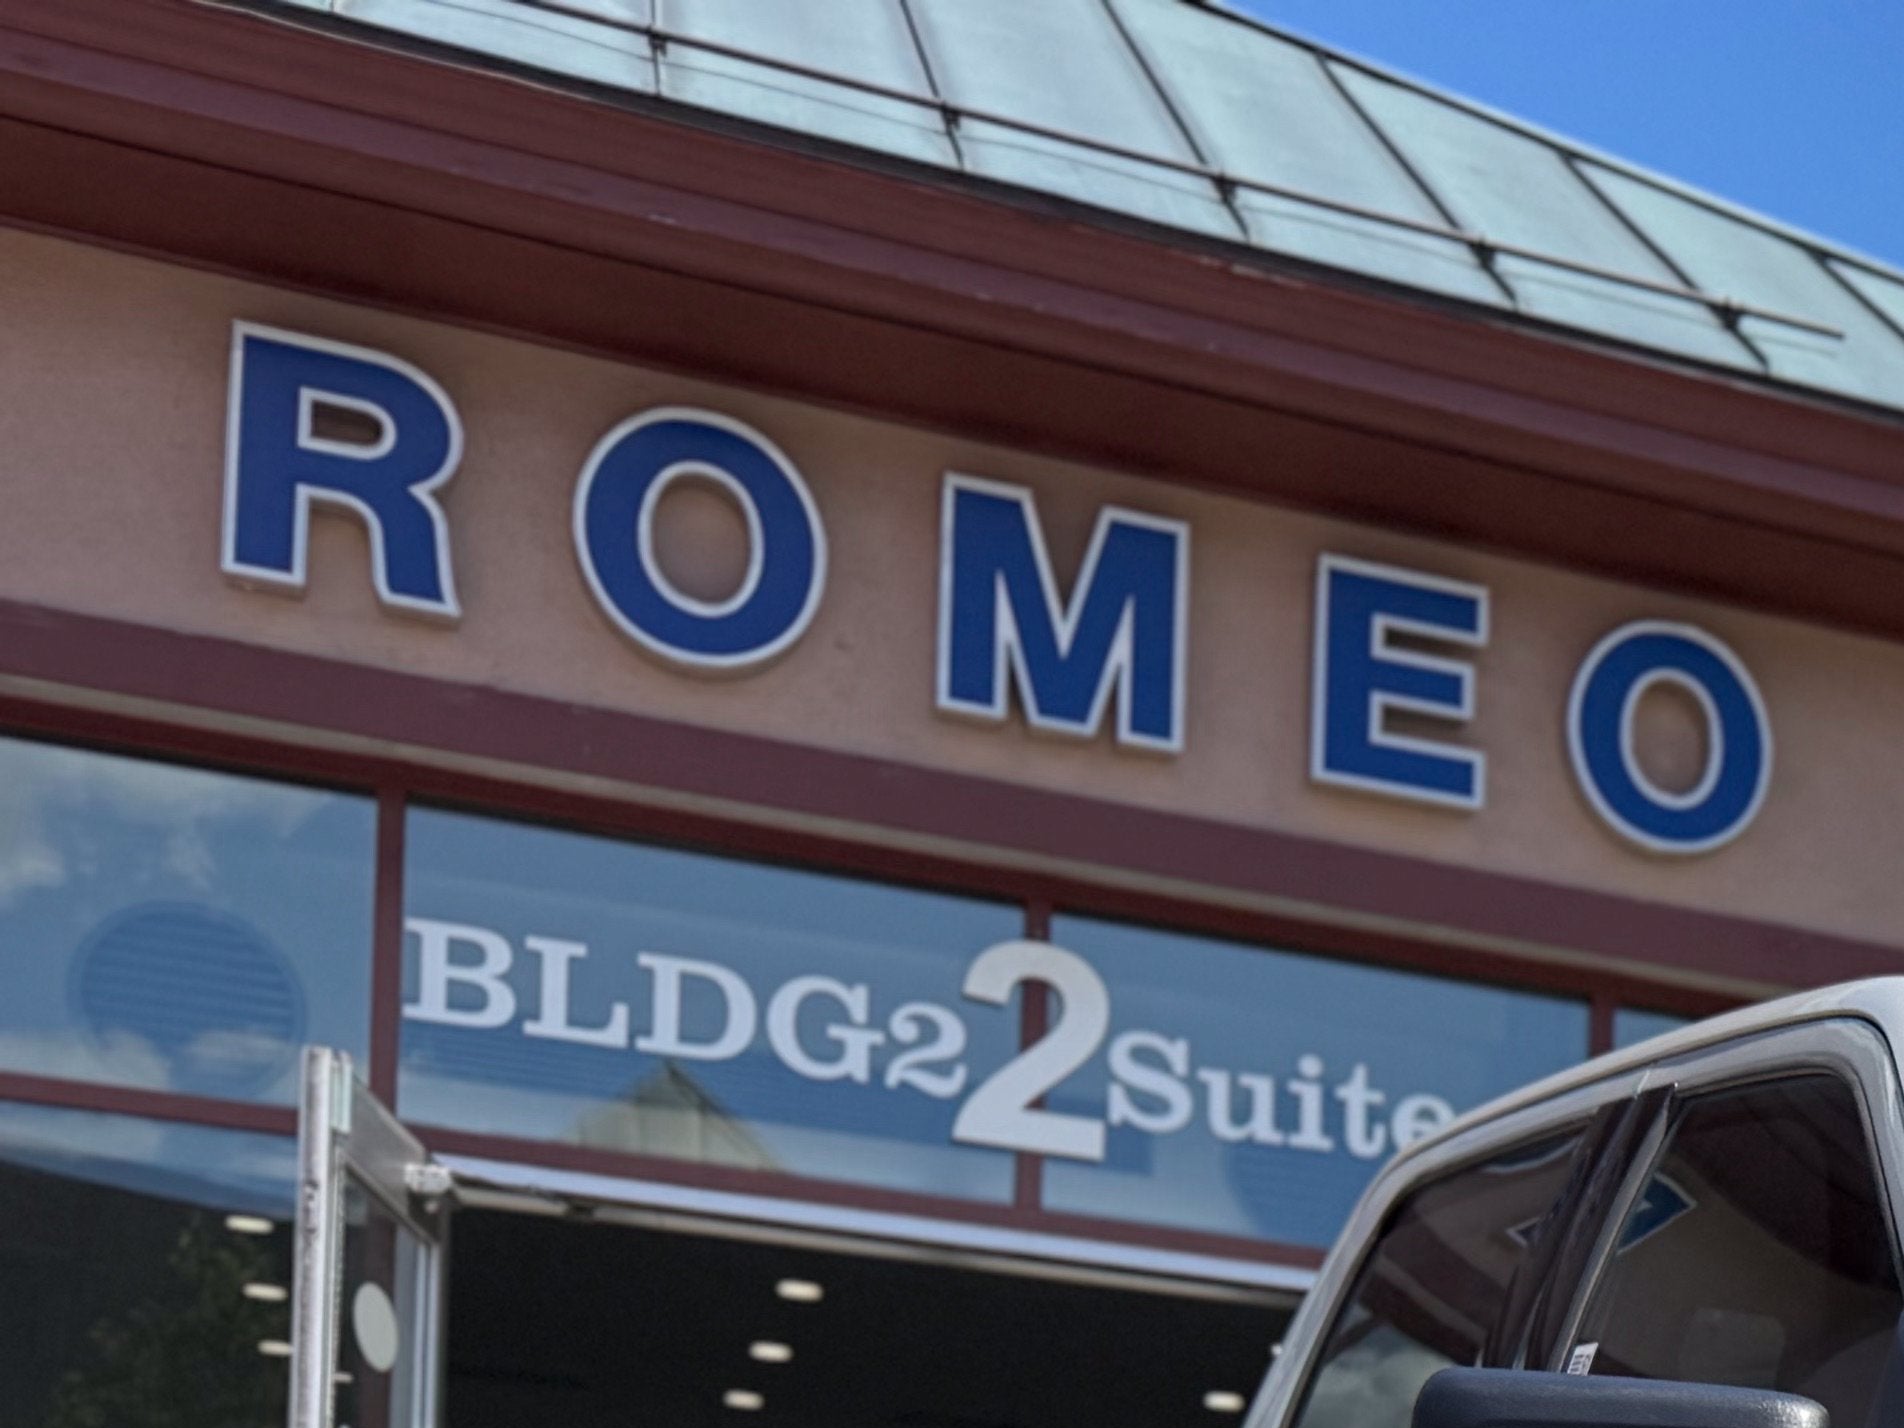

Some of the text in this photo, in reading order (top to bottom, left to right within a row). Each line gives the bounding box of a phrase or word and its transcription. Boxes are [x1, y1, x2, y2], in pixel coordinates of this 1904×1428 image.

[221, 320, 1772, 854] ROMEO
[404, 917, 968, 1098] BLDG2
[952, 940, 1111, 1161] 2
